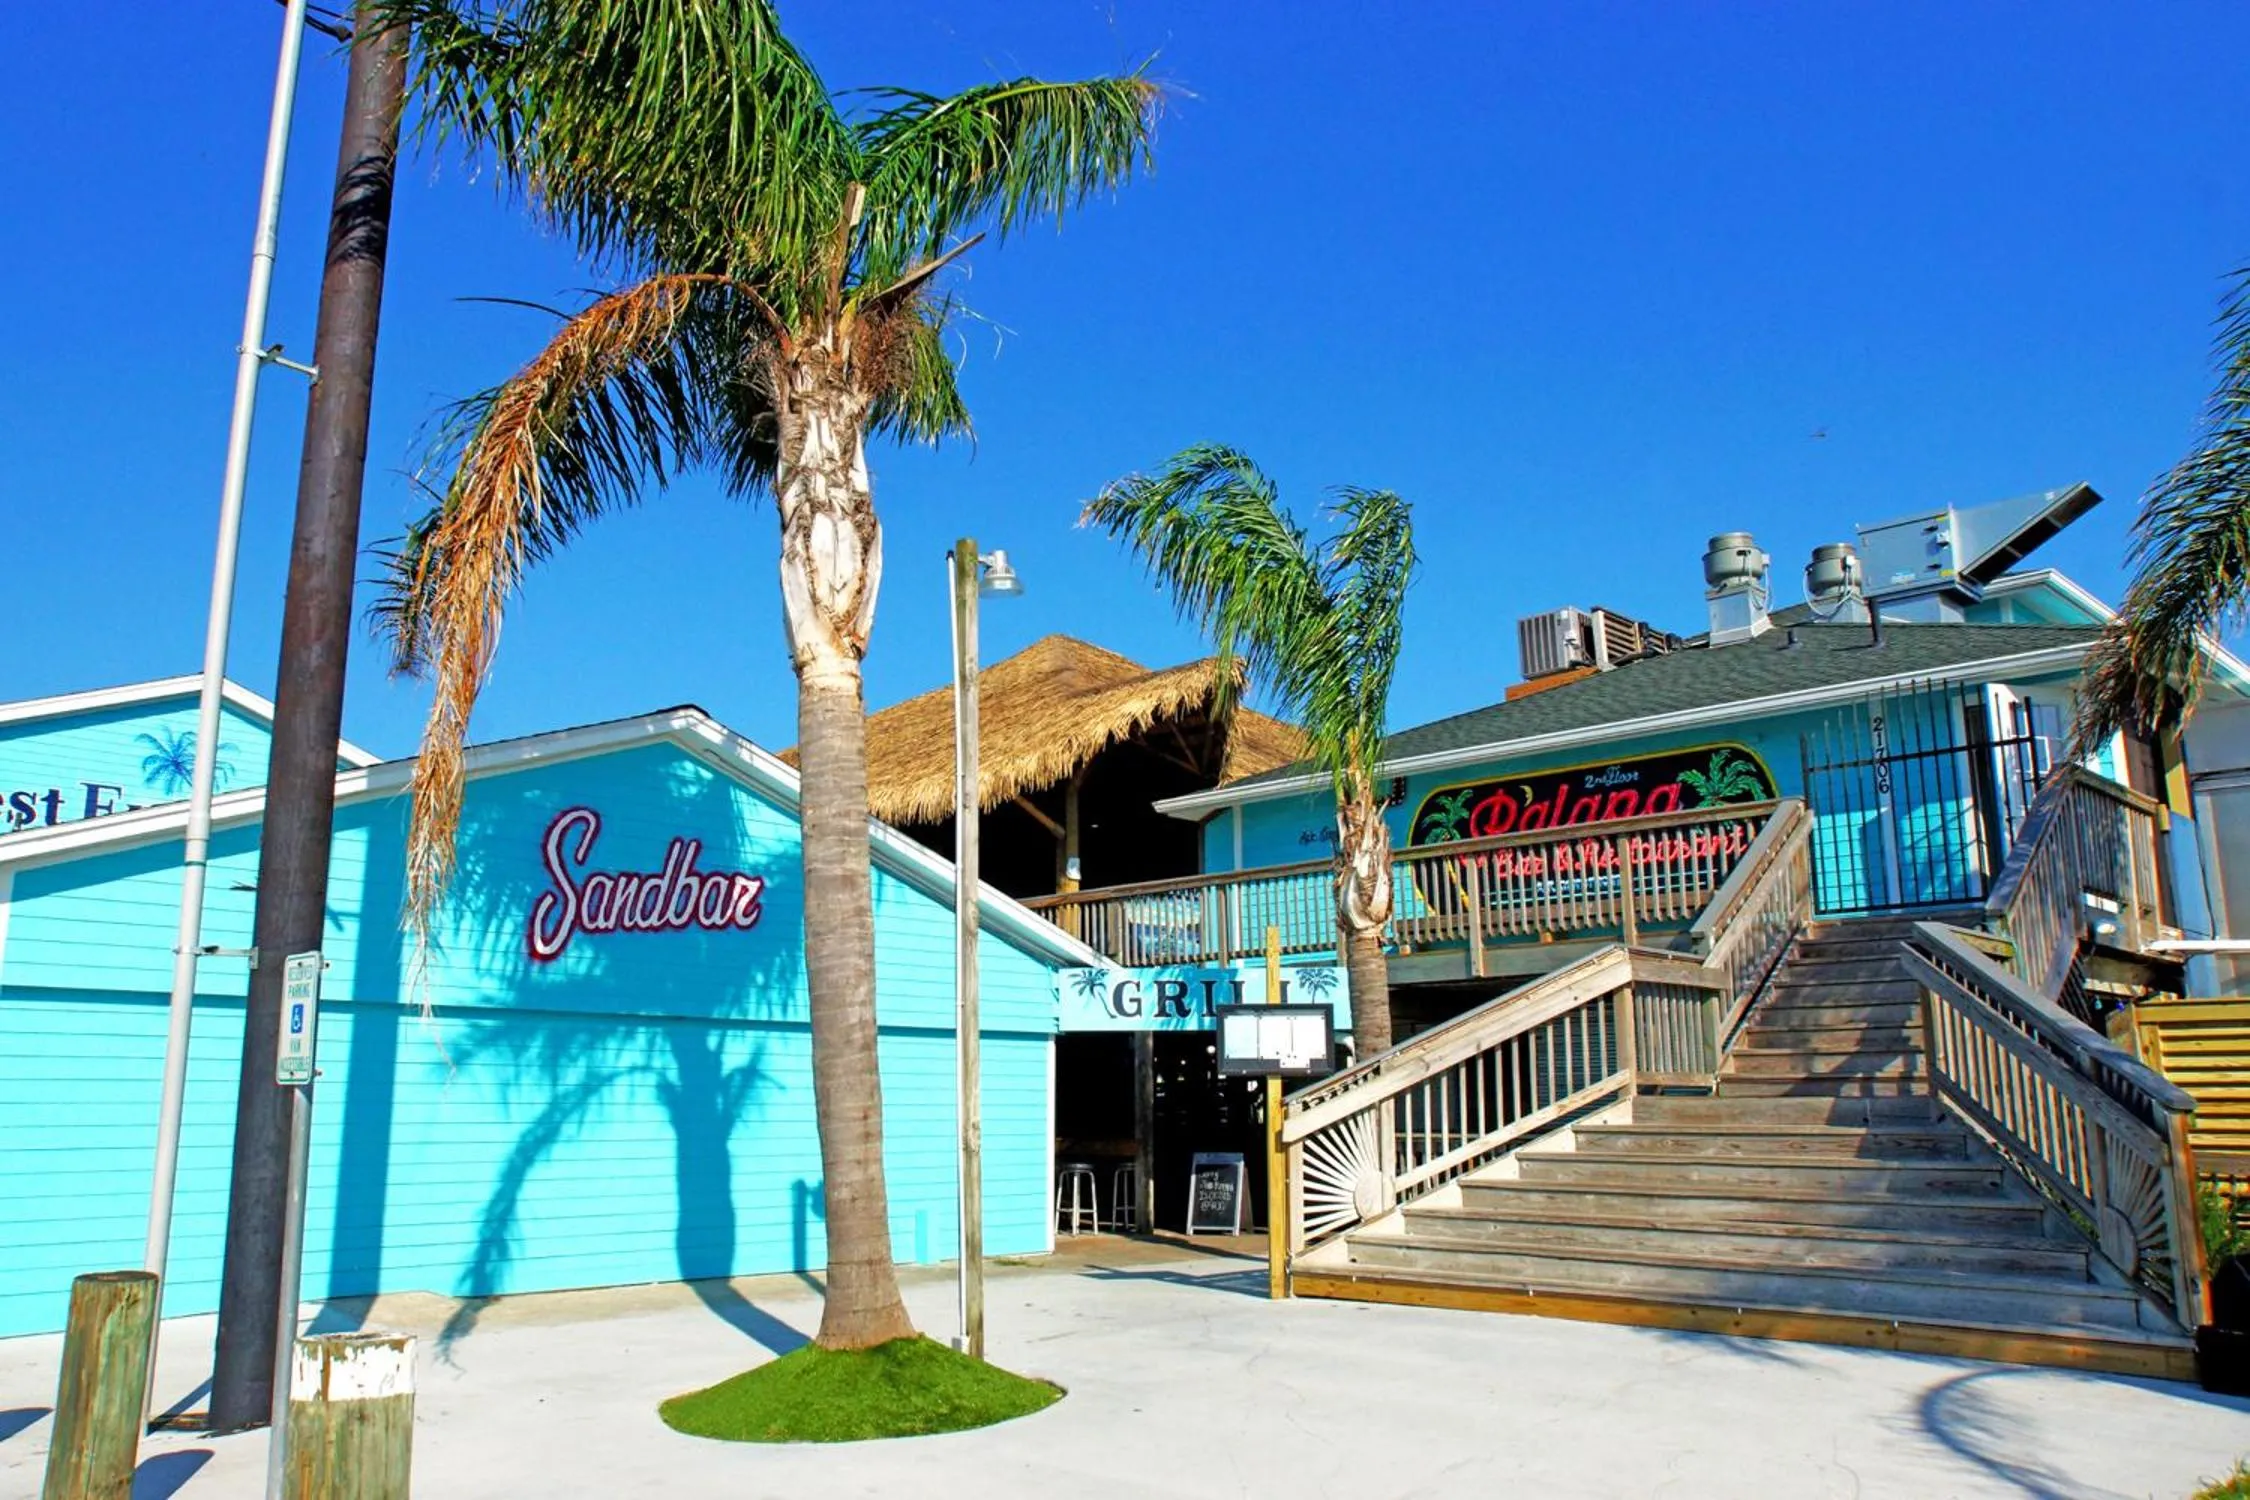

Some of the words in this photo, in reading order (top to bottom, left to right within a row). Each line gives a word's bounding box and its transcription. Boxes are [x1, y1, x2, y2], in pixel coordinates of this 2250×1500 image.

[1872, 716, 1890, 794] 21706
[0, 788, 66, 826] st
[527, 805, 765, 962] Sandbar
